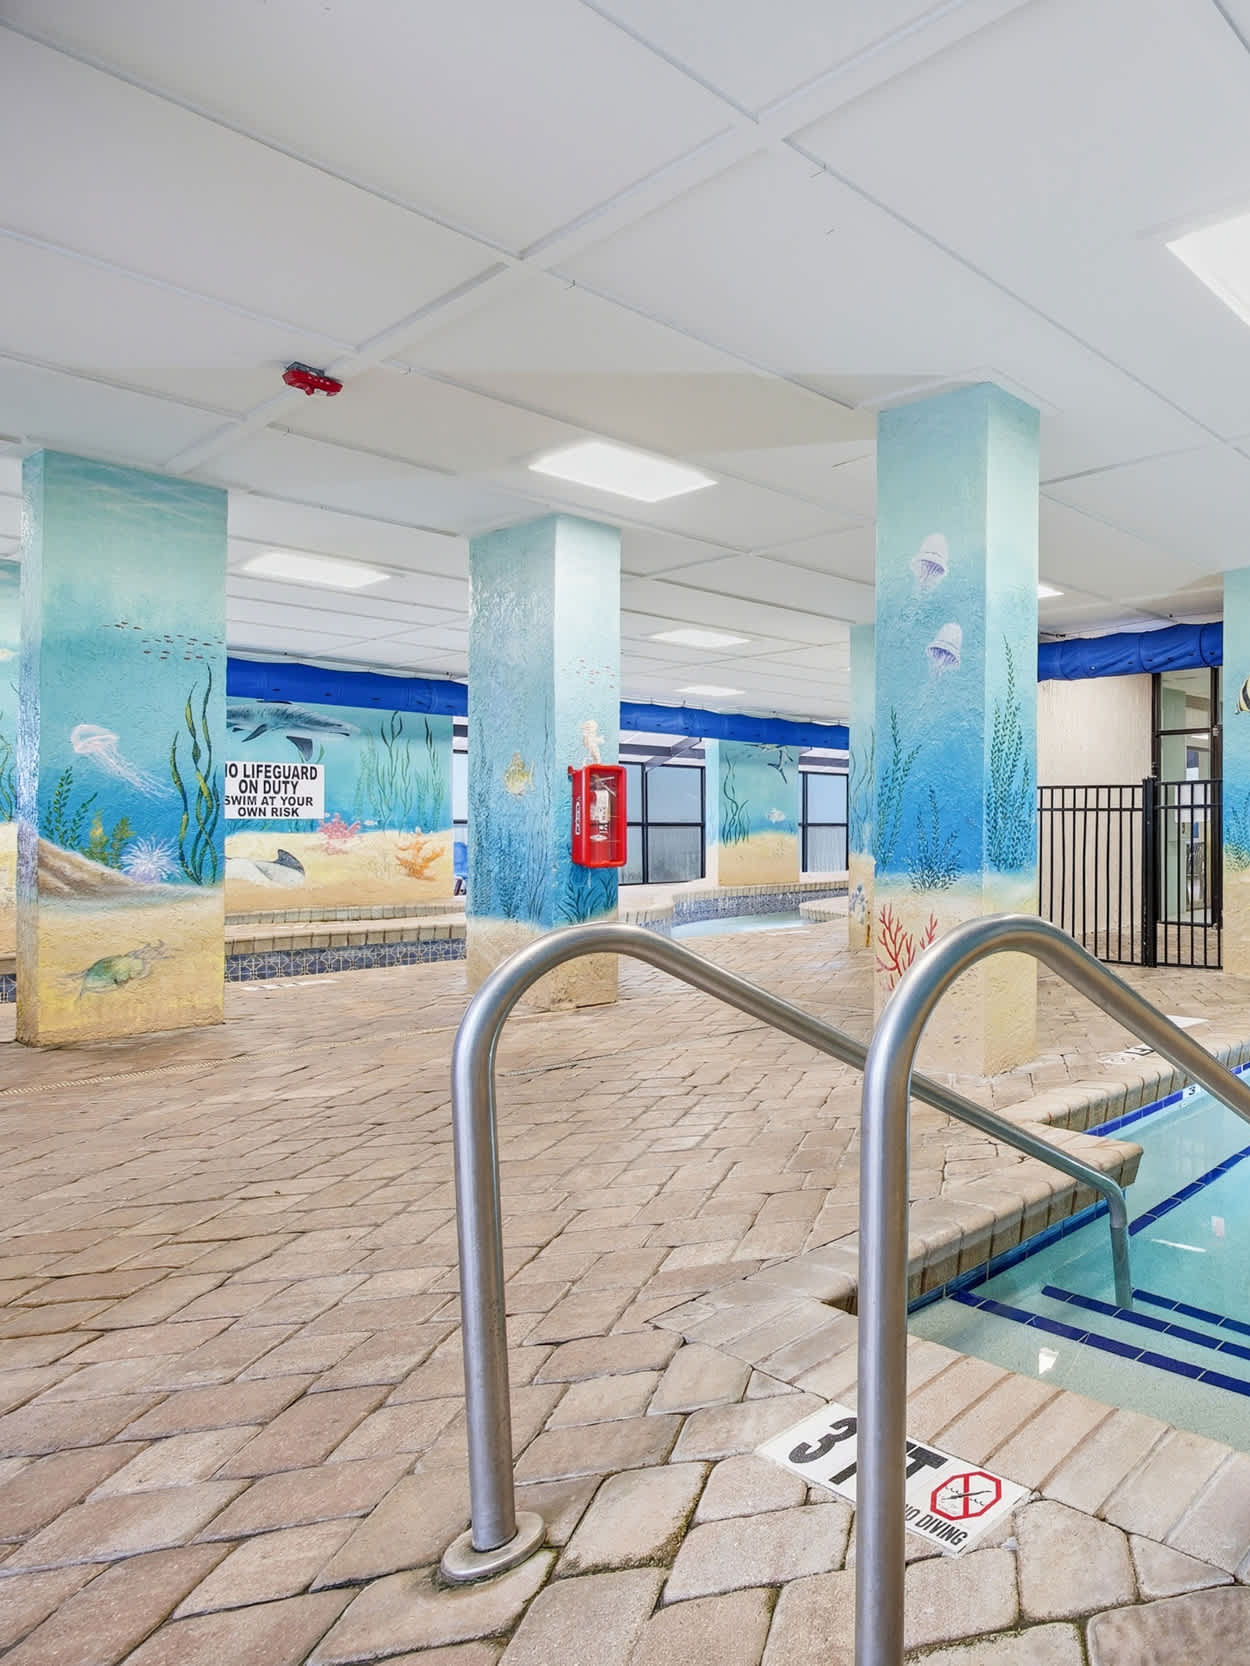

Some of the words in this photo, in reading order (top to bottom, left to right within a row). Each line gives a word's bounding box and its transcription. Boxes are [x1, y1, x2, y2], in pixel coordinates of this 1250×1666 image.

[243, 763, 318, 780] LIFEGUARD
[238, 779, 258, 794] ON
[263, 780, 299, 795] DUTY
[224, 795, 257, 806] SWIM
[261, 796, 277, 806] AT
[280, 796, 314, 807] YOUR
[237, 807, 267, 817] OWN
[271, 807, 300, 817] RISK
[1188, 1086, 1196, 1096] 3
[787, 1416, 858, 1465] 3
[914, 1514, 968, 1546] DIVING
